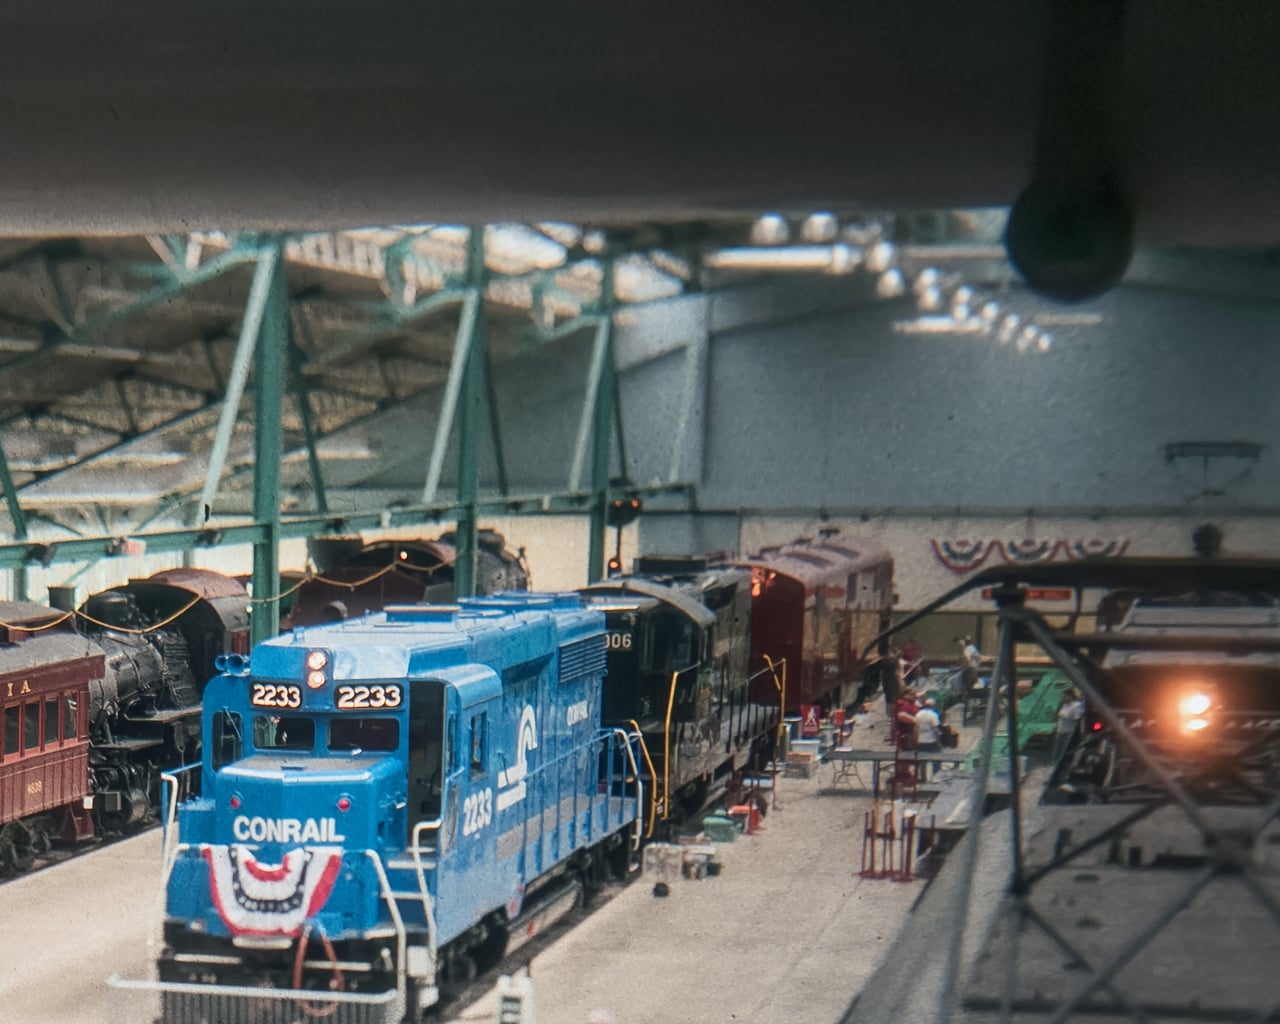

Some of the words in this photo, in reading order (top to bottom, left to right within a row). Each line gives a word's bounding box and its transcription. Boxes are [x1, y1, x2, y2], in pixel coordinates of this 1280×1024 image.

[252, 684, 301, 708] 2233
[338, 685, 401, 708] 2233
[463, 787, 492, 836] 2233
[233, 815, 345, 842] CONRAIL
